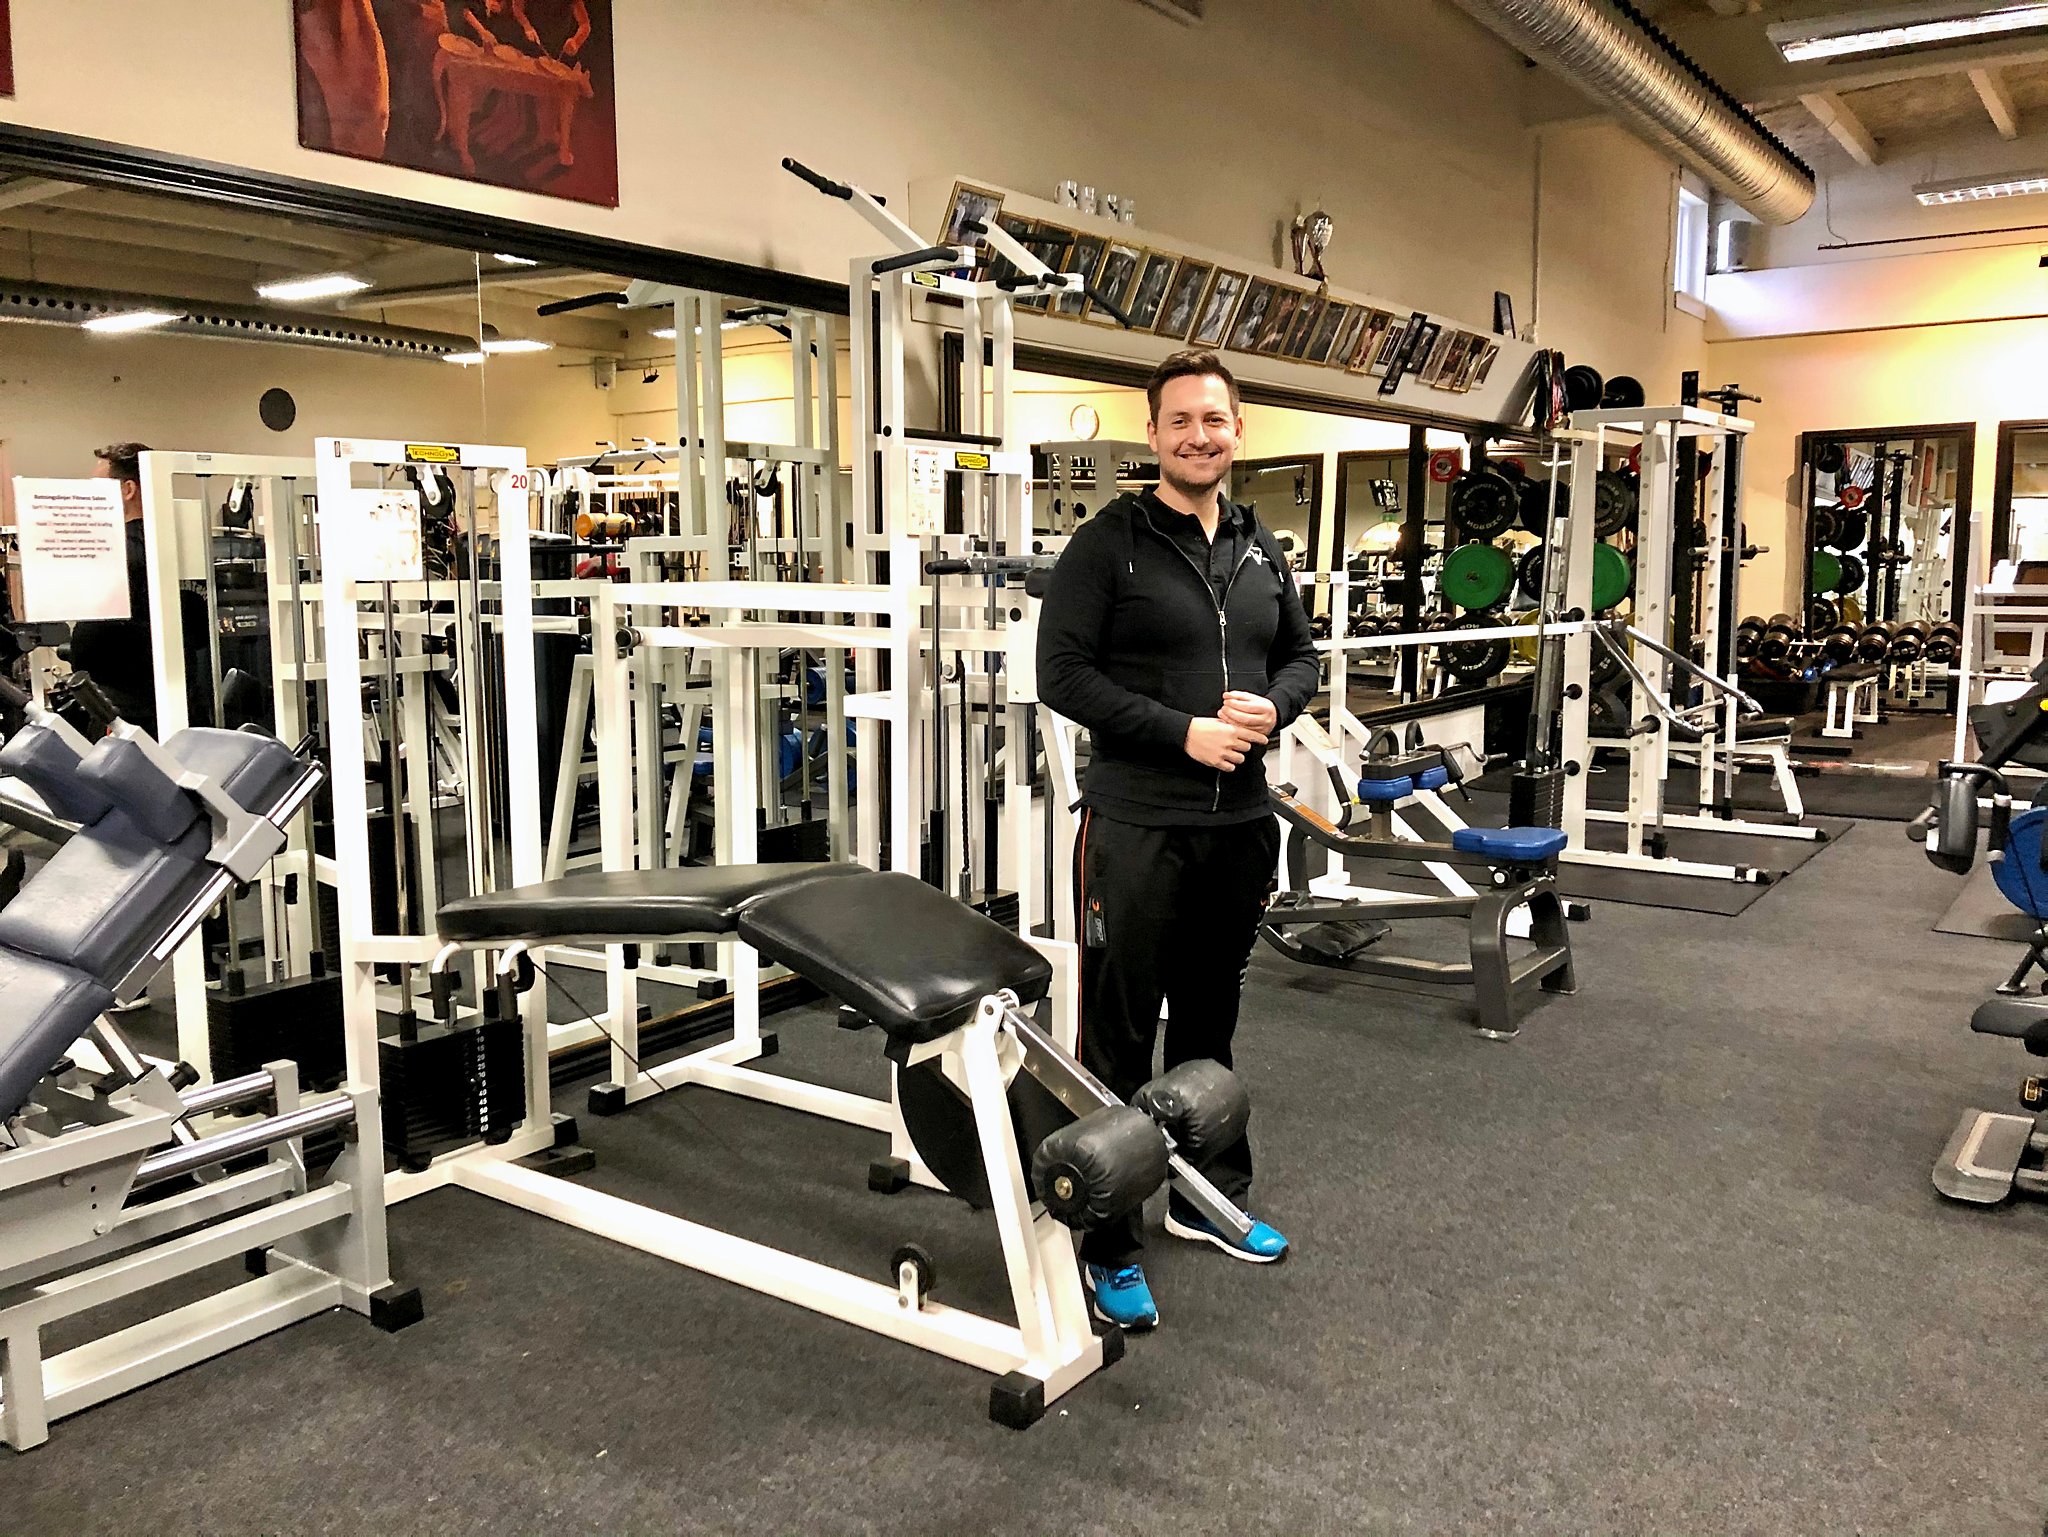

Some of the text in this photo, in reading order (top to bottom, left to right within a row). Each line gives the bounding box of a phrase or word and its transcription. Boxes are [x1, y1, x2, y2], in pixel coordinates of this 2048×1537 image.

[411, 448, 455, 459] TECHNOGYM
[511, 474, 528, 489] 20
[1024, 481, 1031, 495] 9
[477, 1044, 485, 1052] 15
[477, 1053, 486, 1062] 20
[478, 1062, 486, 1070] 25
[478, 1088, 487, 1096] 40
[479, 1097, 488, 1105] 45
